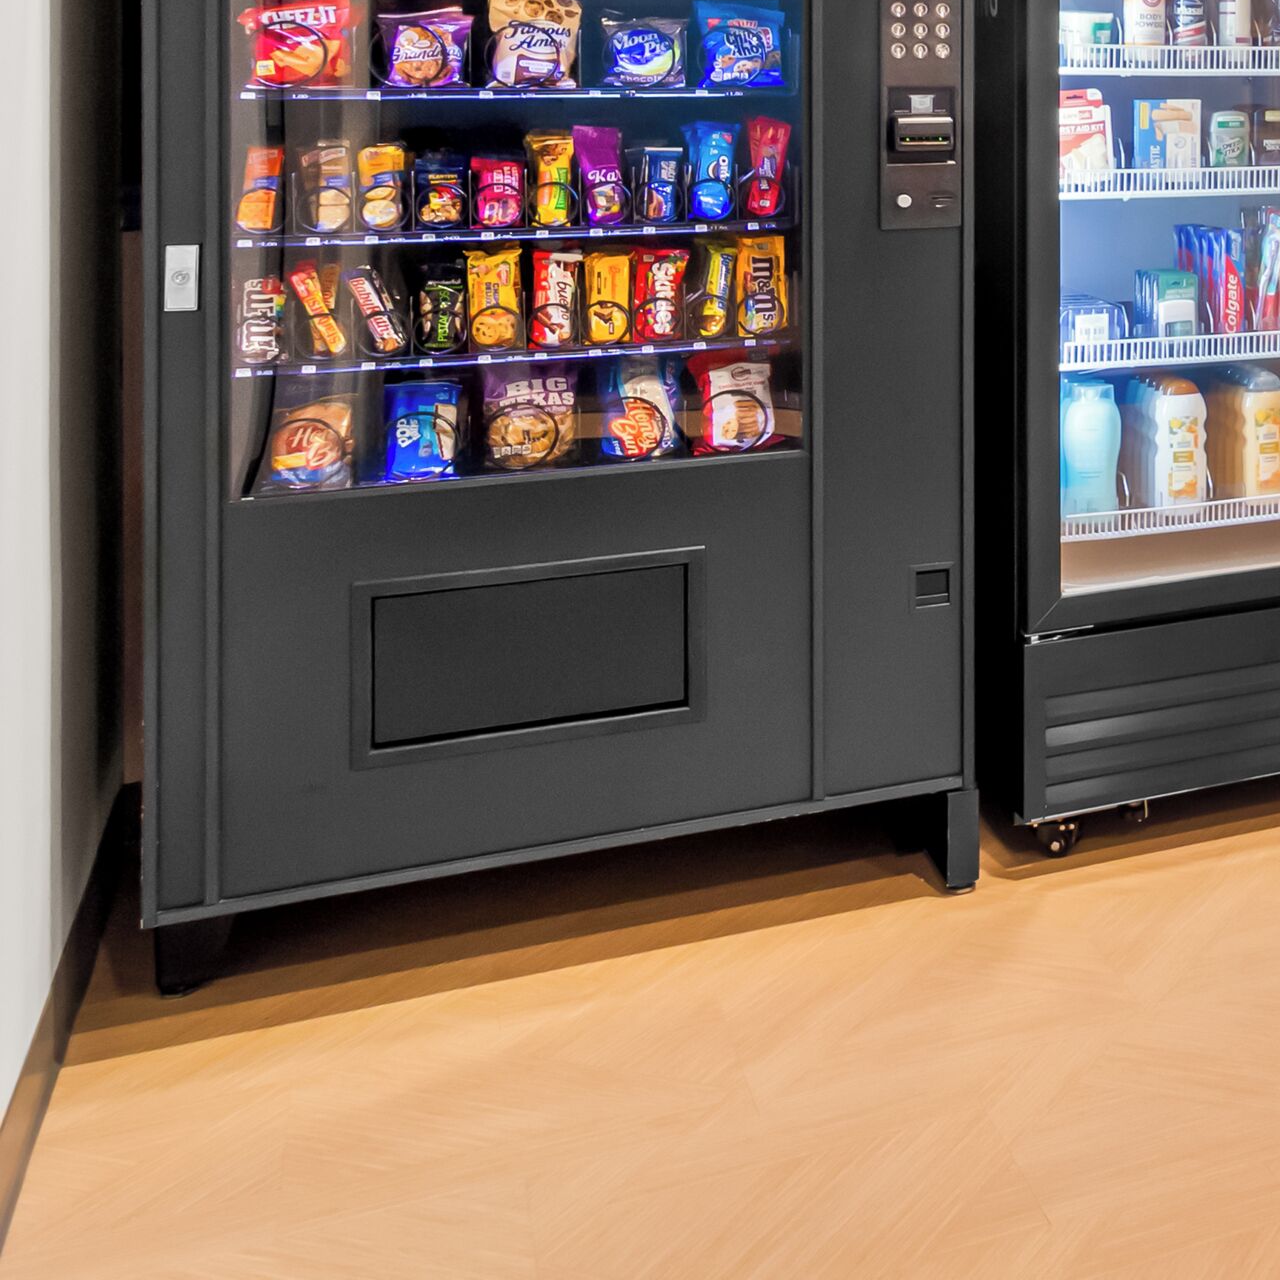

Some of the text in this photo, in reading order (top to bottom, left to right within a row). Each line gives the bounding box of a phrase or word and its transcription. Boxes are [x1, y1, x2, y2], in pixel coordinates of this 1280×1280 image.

[505, 20, 571, 38] Famous
[509, 35, 562, 51] Amos
[613, 32, 658, 51] Moon
[643, 41, 669, 58] Pie
[557, 281, 569, 321] bueno
[652, 262, 673, 335] Skittles
[1225, 272, 1239, 333] Colgate
[506, 377, 568, 398] BIG
[499, 391, 575, 407] TEXAS
[628, 400, 658, 452] Honey
[611, 419, 639, 455] Bun
